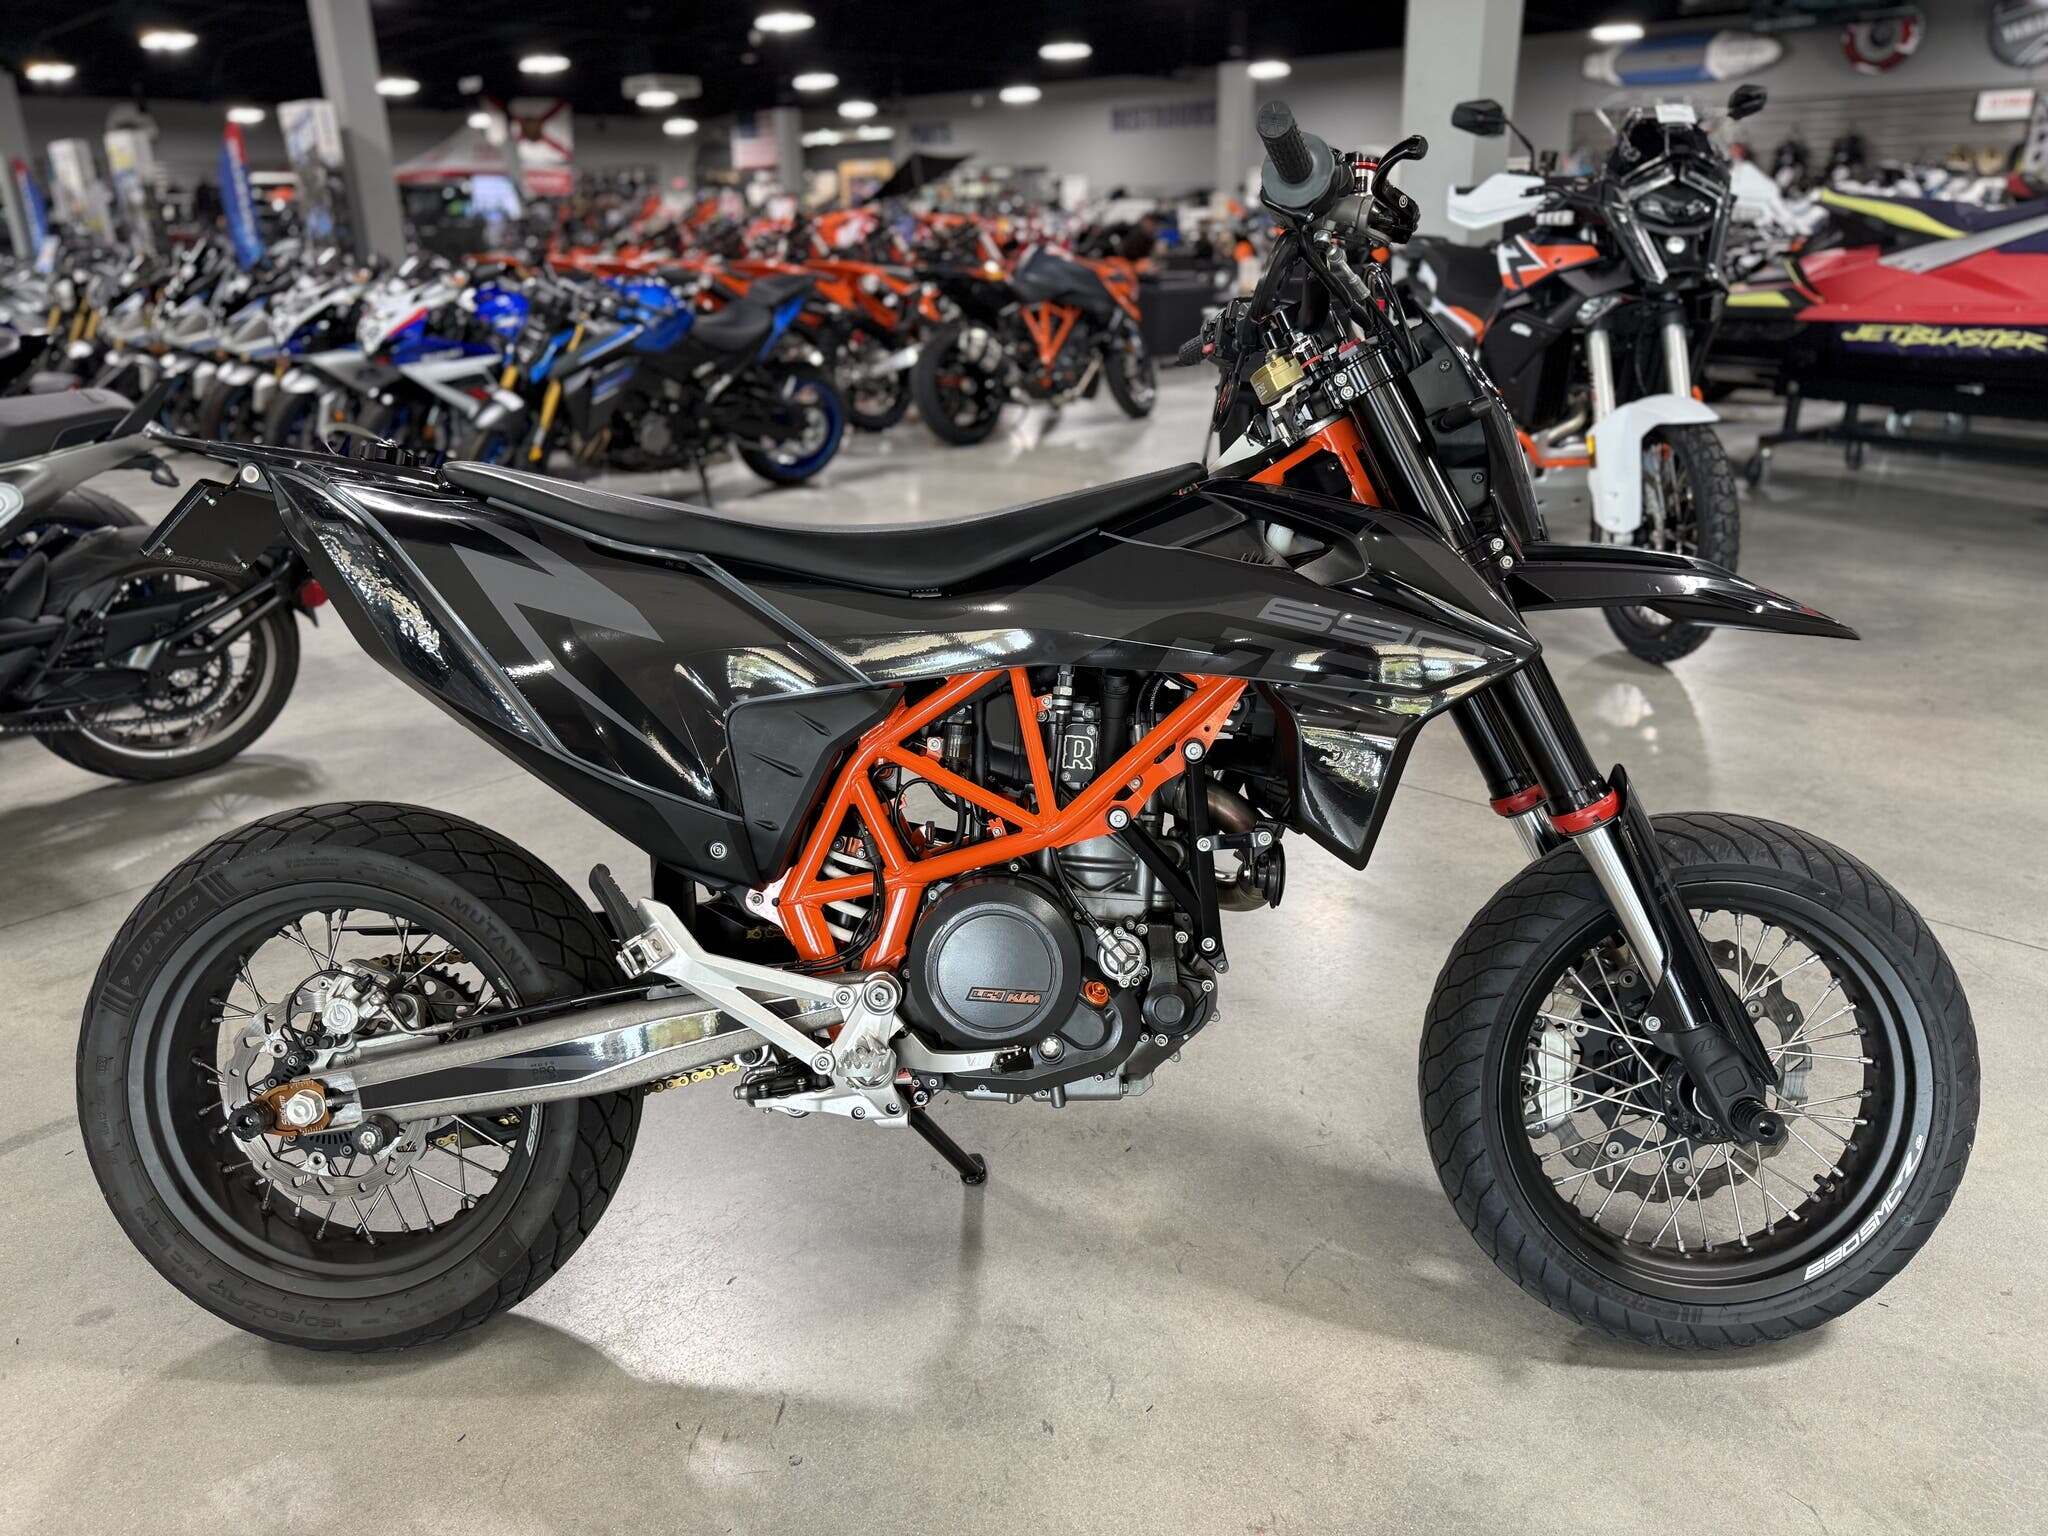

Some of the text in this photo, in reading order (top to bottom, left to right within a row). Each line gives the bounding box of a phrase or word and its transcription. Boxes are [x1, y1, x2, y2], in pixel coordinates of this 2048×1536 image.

[1841, 322, 2047, 353] JETBLASTER
[1062, 734, 1094, 770] R
[131, 895, 201, 972] DUNLOP
[450, 896, 533, 976] MUTANT
[1007, 992, 1041, 1005] KTM
